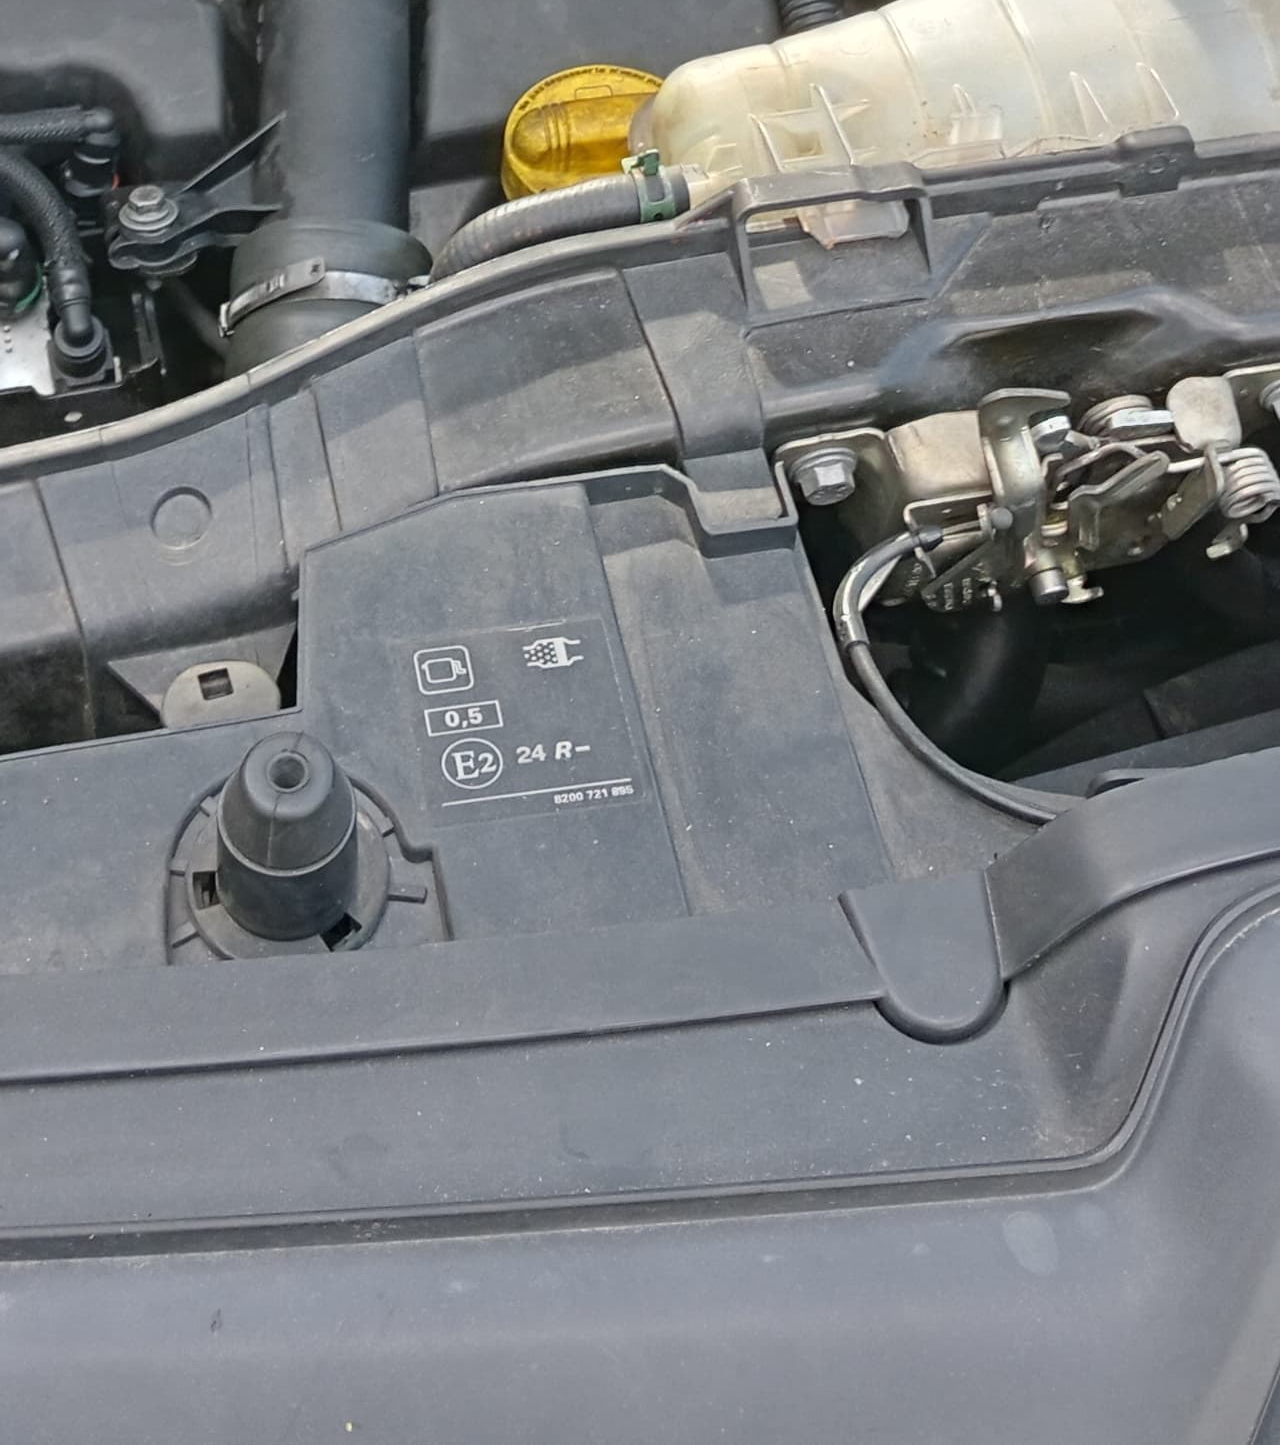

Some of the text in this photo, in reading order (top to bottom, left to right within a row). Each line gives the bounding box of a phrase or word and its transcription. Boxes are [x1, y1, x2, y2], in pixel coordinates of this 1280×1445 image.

[444, 708, 483, 730] 0,5
[451, 750, 497, 780] E2
[516, 746, 546, 764] 24
[553, 792, 584, 804] 8200
[586, 788, 608, 800] 721
